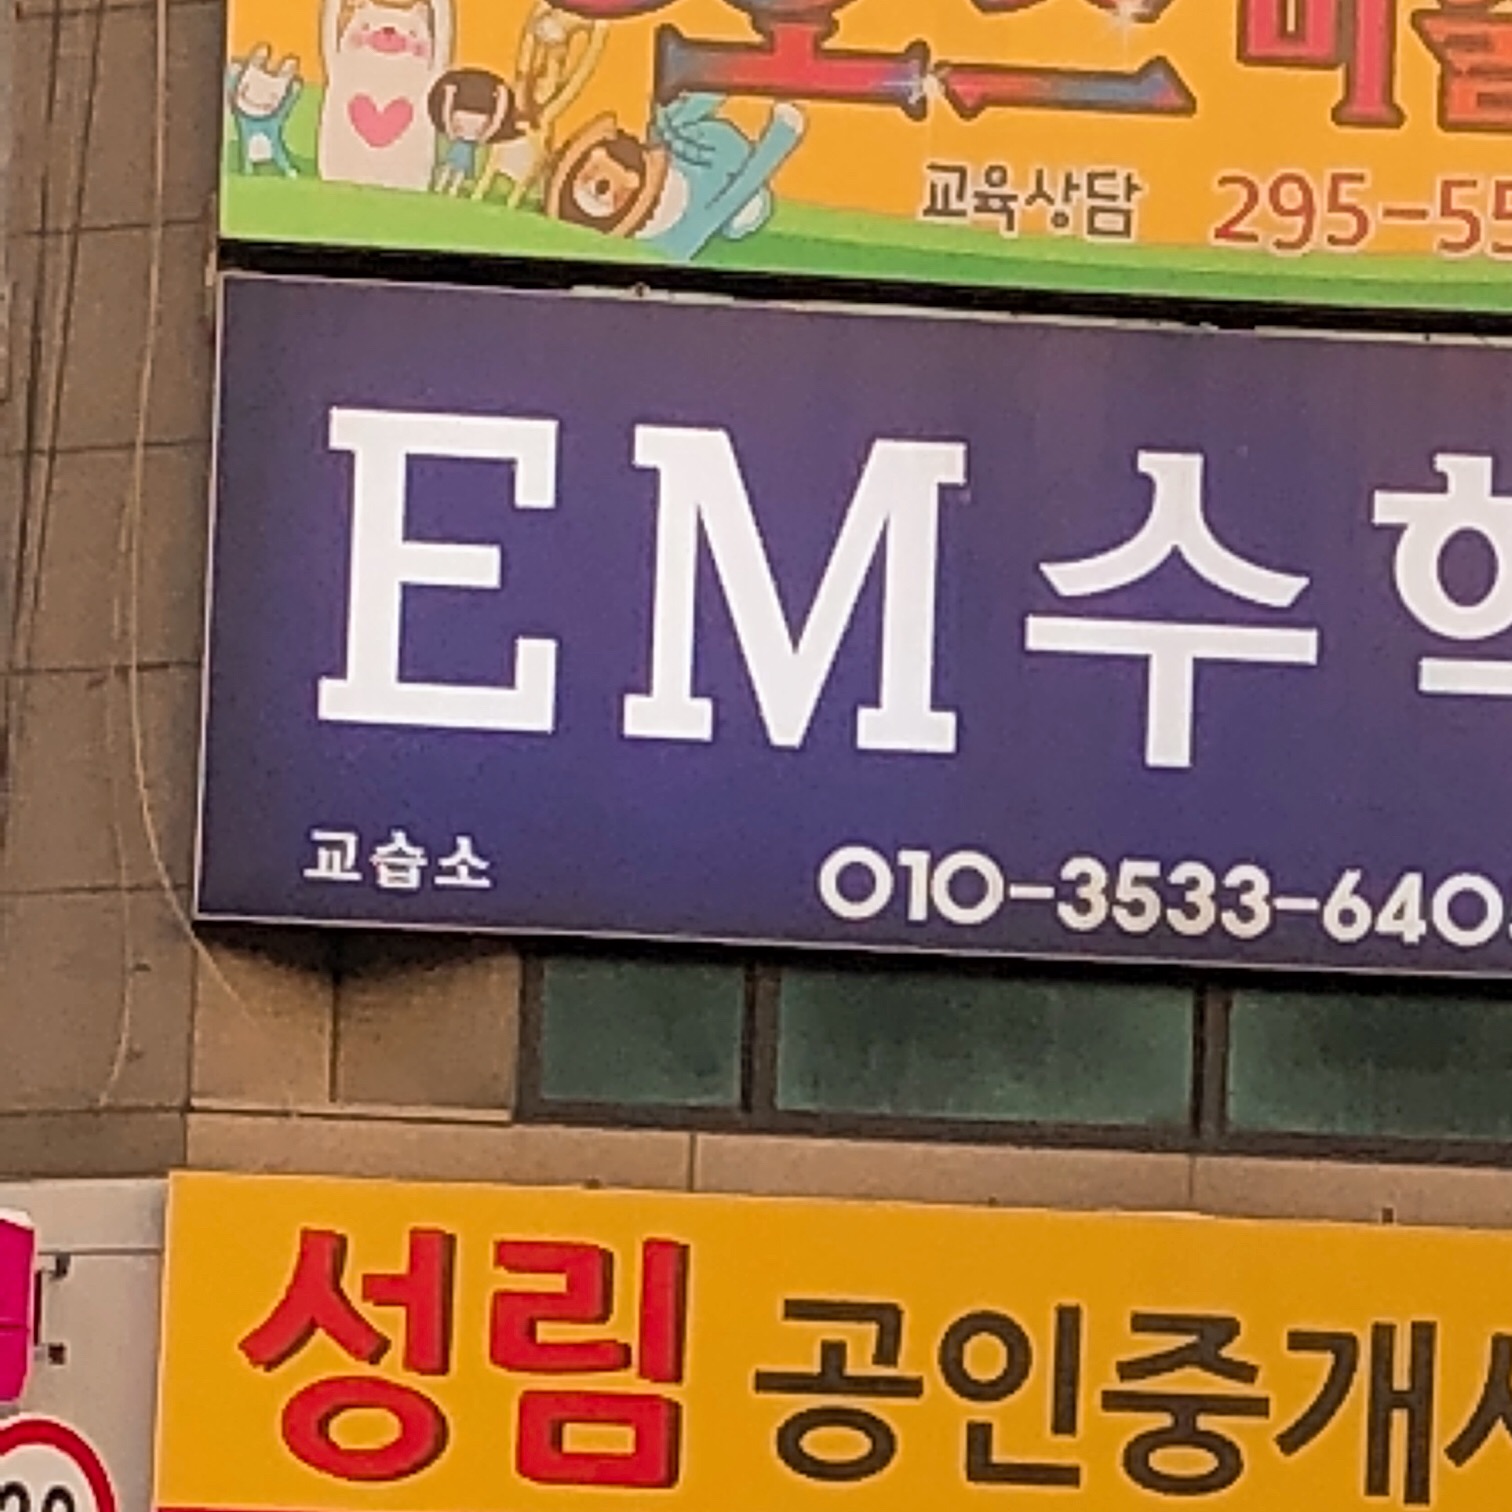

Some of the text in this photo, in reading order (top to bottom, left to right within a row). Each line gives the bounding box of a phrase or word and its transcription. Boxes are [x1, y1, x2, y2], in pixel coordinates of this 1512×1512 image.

[922, 162, 1142, 240] 교육상담
[303, 828, 493, 892] 교습소
[238, 1226, 690, 1489] 성림
